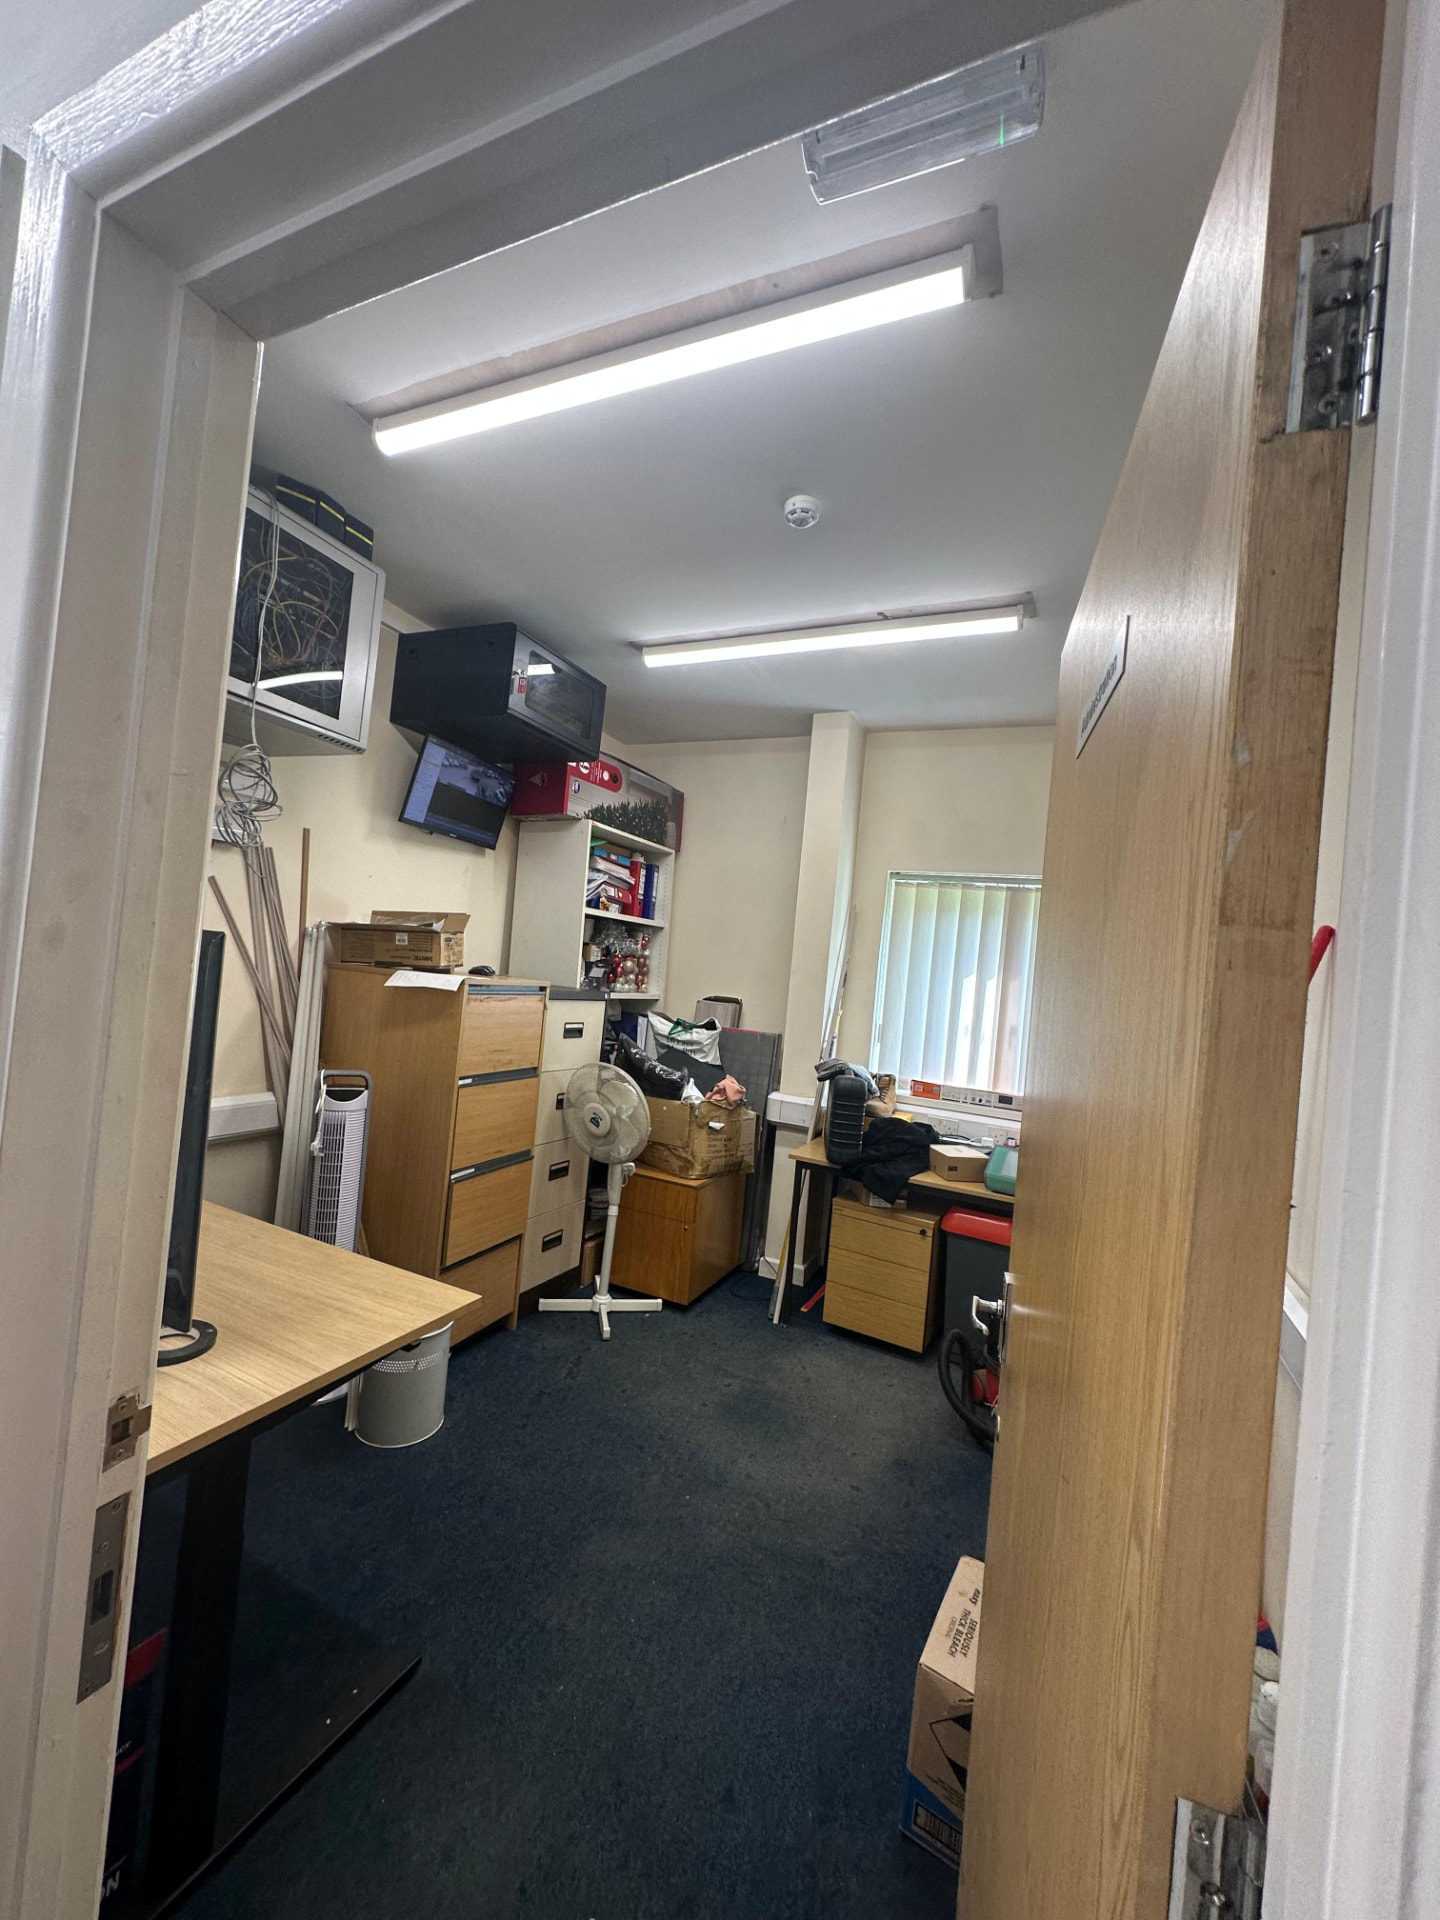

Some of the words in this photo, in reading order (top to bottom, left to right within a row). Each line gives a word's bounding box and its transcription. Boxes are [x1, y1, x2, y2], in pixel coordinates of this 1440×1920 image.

[969, 1588, 981, 1606] easy
[958, 1608, 971, 1629] THICK
[948, 1628, 964, 1657] BLEACH
[959, 1618, 977, 1657] SERIOUSLY
